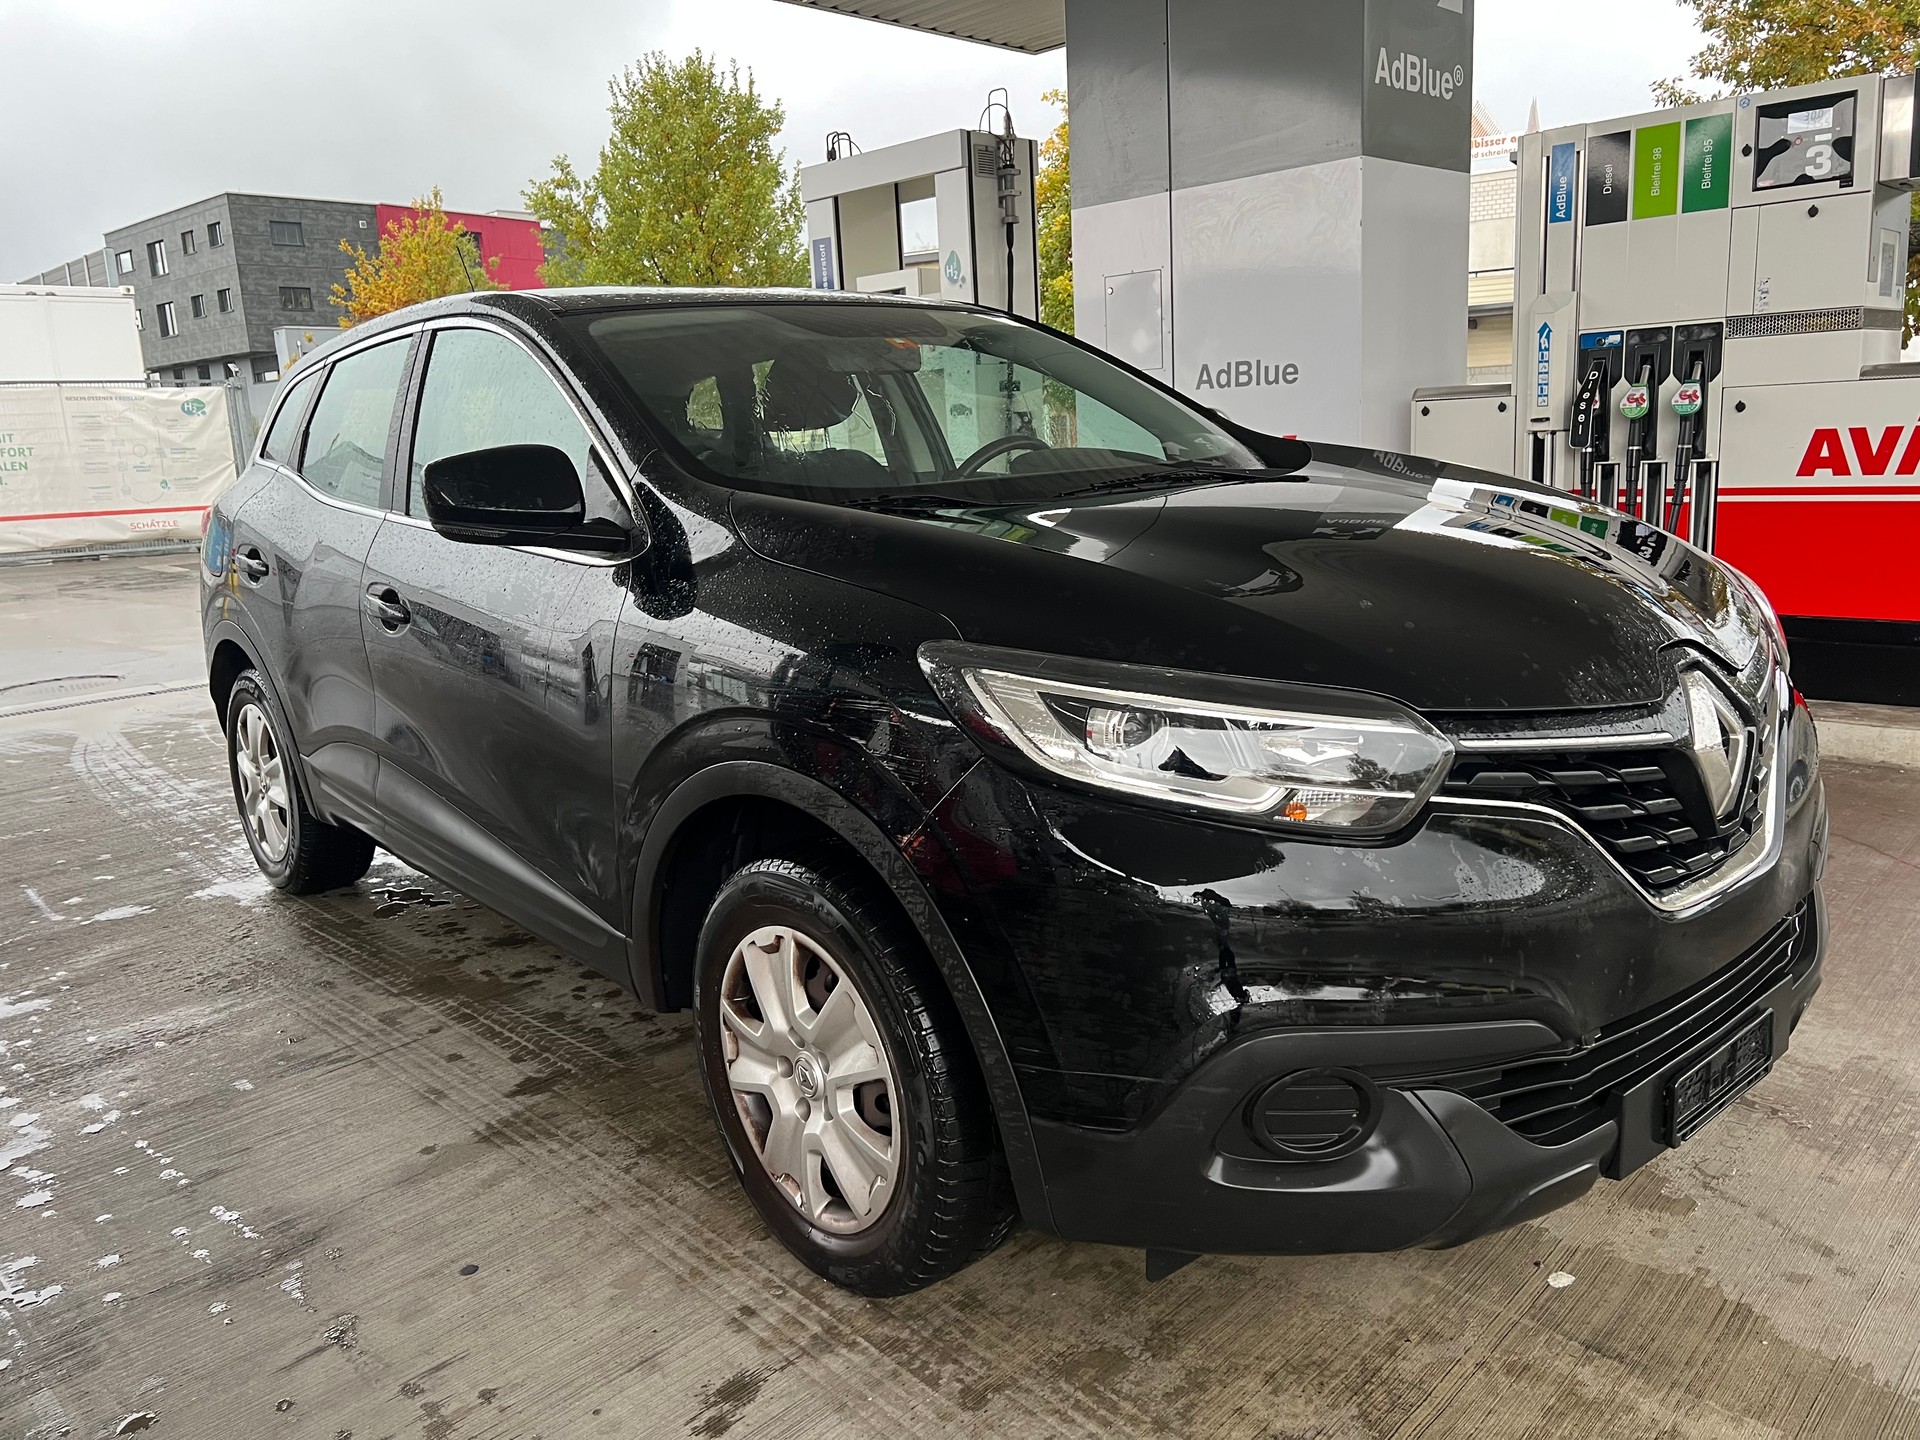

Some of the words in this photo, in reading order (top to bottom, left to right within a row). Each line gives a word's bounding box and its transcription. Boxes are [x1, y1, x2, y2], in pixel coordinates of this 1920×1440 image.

[1652, 147, 1662, 160] 98
[1703, 139, 1713, 152] 95
[1804, 144, 1833, 177] 3
[1603, 164, 1613, 195] Diesel
[1651, 162, 1661, 196] Bleifrei
[1701, 155, 1712, 189] Bleifrei
[1195, 359, 1299, 390] AdBlue
[1578, 371, 1599, 435] Diesel
[0, 433, 14, 443] IT
